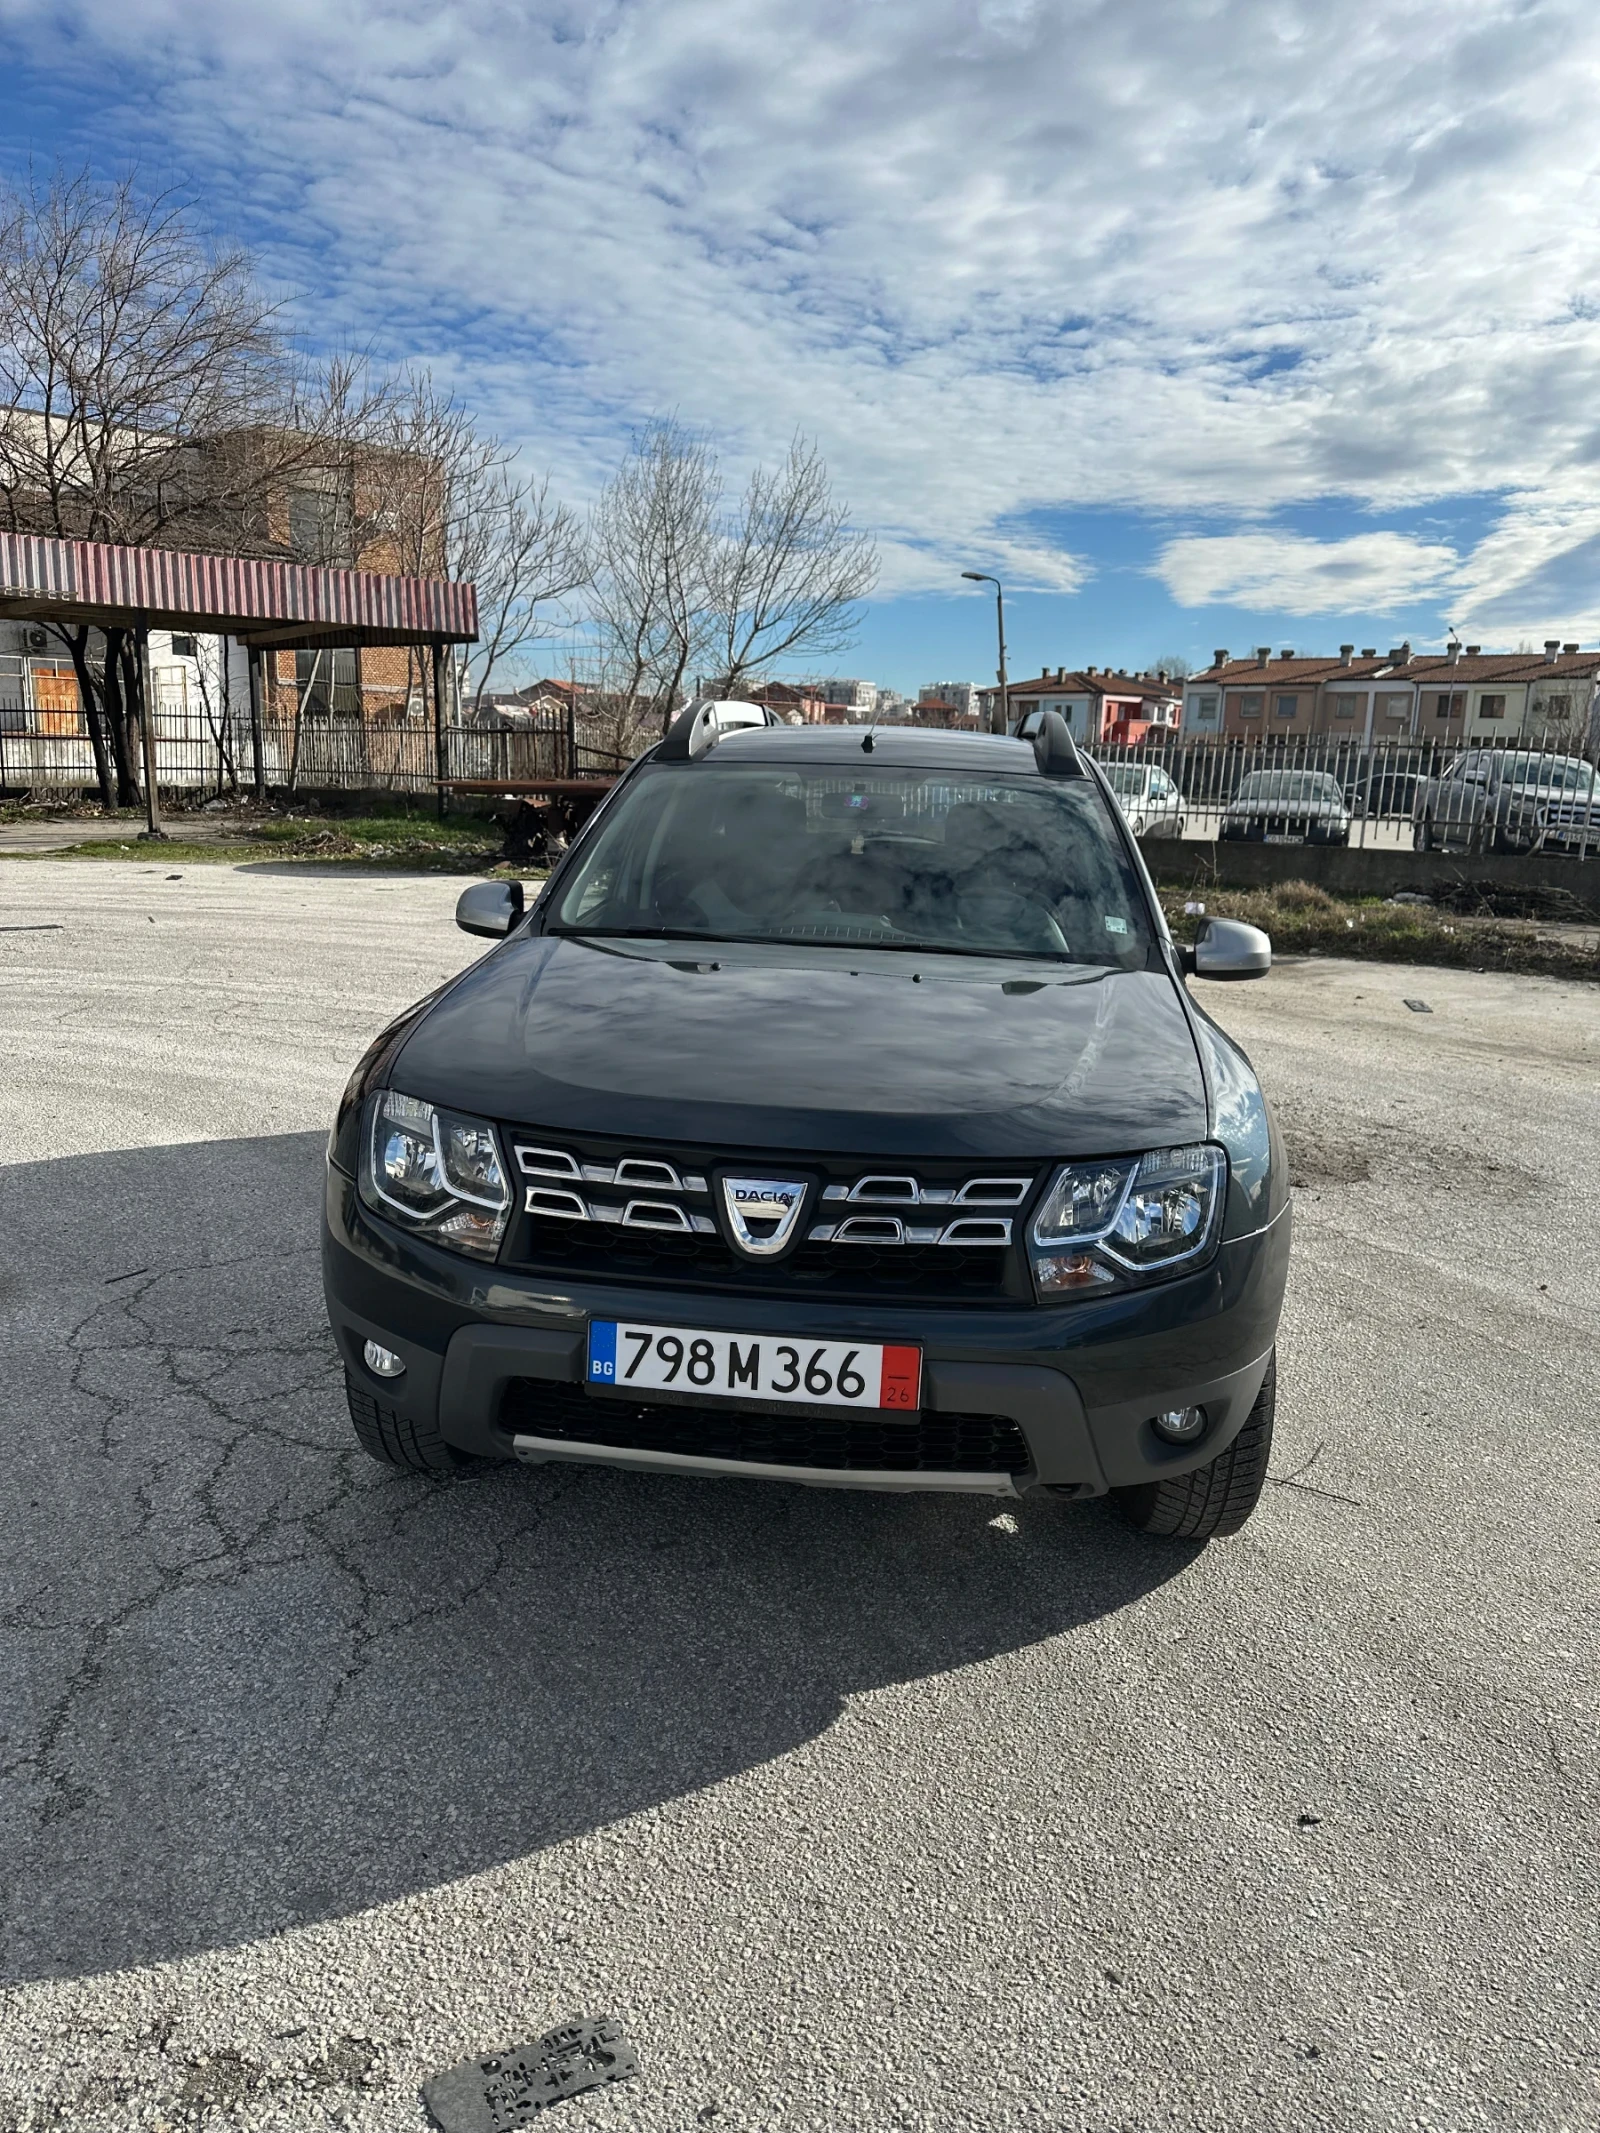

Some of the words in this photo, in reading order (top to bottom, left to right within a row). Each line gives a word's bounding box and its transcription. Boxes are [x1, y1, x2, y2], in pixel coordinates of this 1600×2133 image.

[736, 1190, 790, 1202] DACIA
[592, 1360, 613, 1376] BG
[624, 1331, 715, 1386] 798
[728, 1341, 760, 1391] M
[771, 1346, 866, 1399] 366
[887, 1386, 910, 1403] 26
